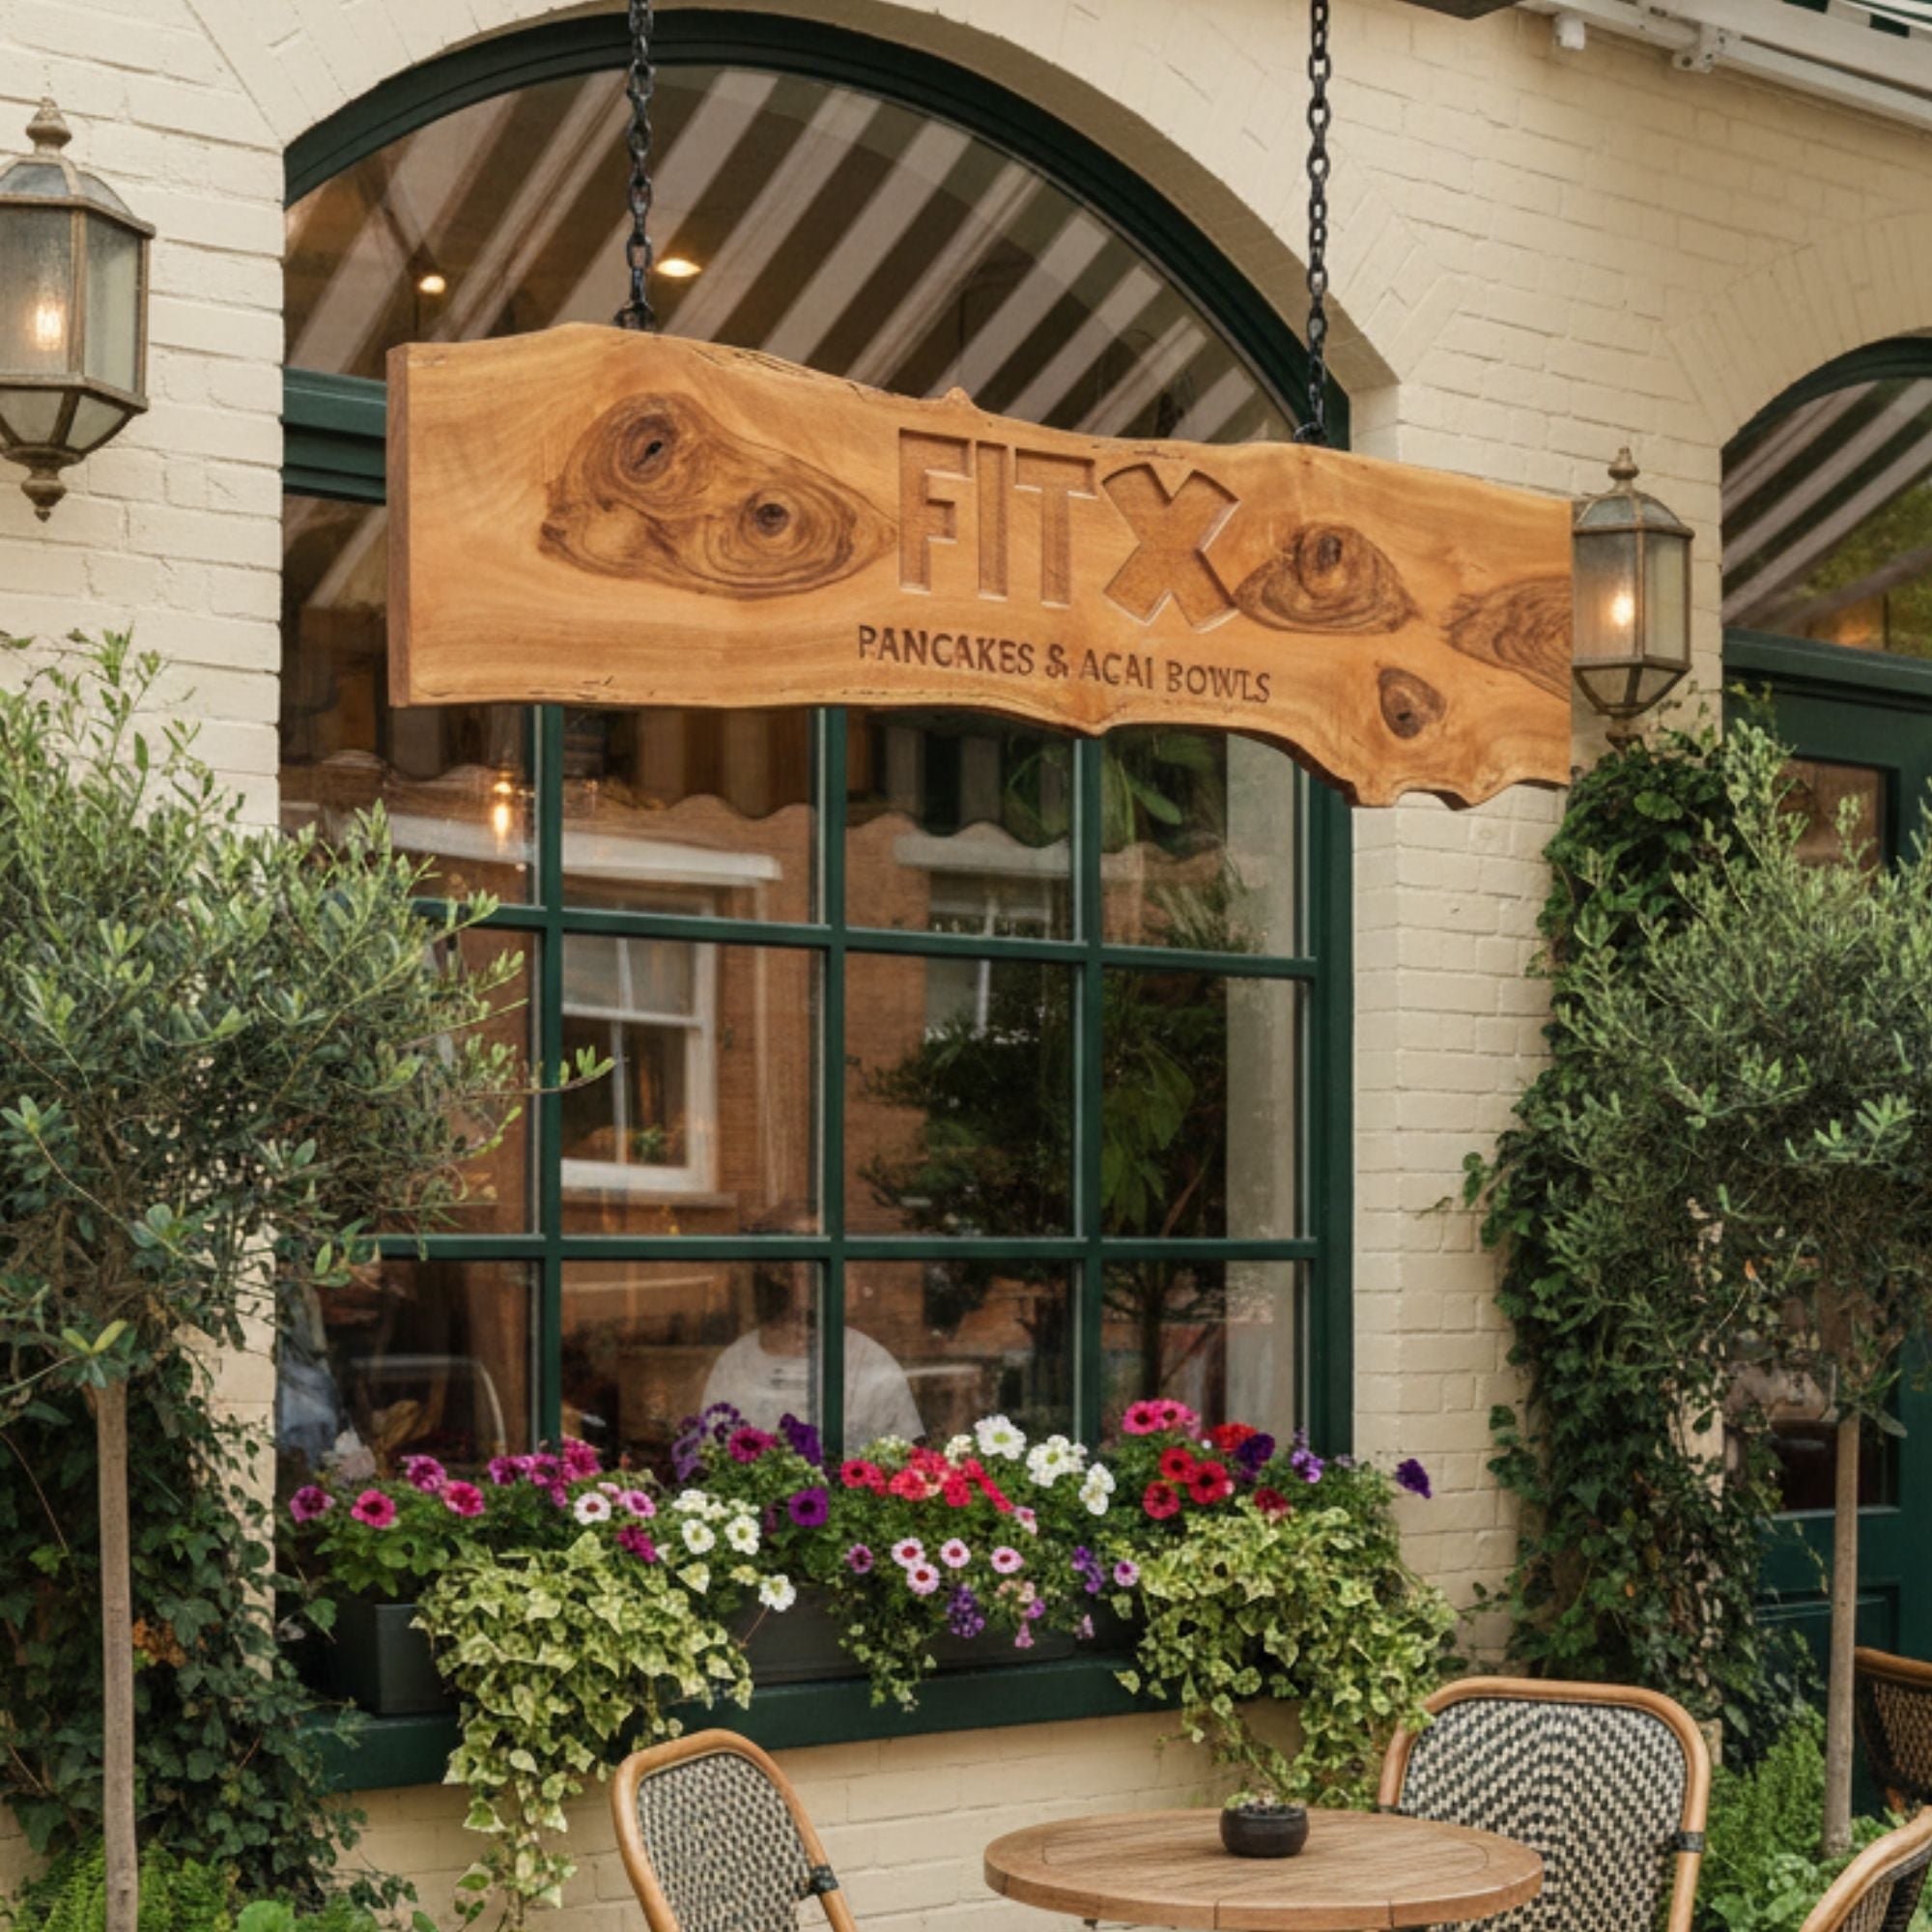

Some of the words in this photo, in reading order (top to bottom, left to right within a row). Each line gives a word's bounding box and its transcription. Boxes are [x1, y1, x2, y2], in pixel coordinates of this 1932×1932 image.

[859, 624, 1035, 676] PANCAKES
[1045, 642, 1068, 678] &
[1079, 648, 1153, 690] ACAI
[1166, 660, 1270, 703] BOWLS
